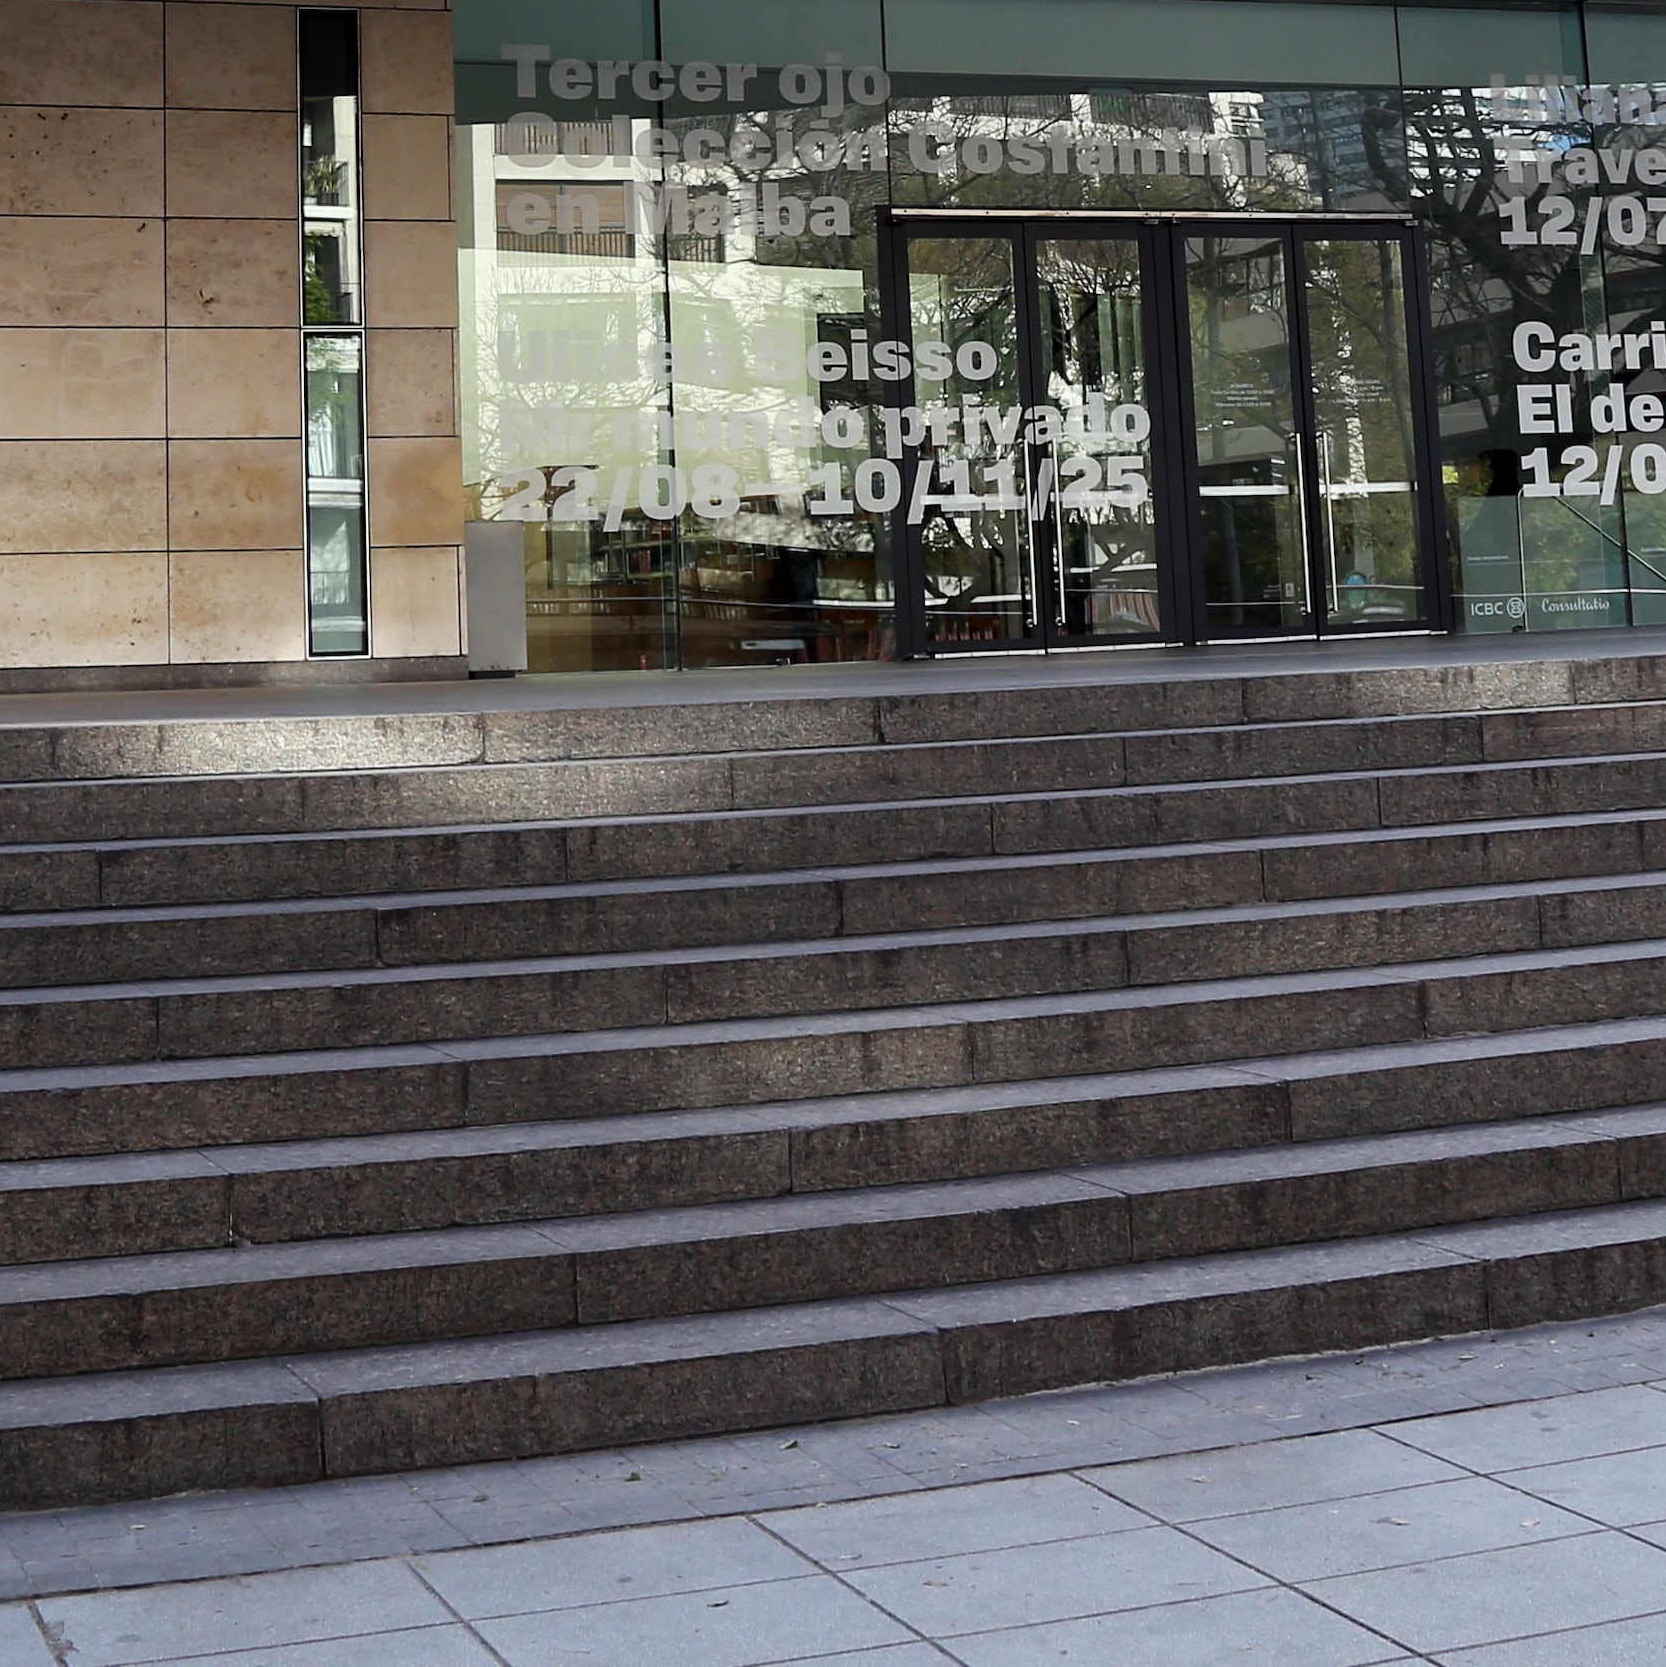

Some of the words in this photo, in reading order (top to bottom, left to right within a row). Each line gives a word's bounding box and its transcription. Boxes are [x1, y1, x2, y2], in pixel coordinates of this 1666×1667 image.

[501, 43, 757, 102] Tercer
[779, 52, 891, 118] ojo
[505, 111, 887, 172] Colección
[908, 120, 1267, 177] Costantini
[505, 191, 600, 235] en
[624, 181, 851, 236] Malba
[885, 391, 1151, 460] privado
[1517, 383, 1574, 434] El
[1471, 601, 1504, 616] ICBC
[1541, 595, 1610, 614] Consultatio
